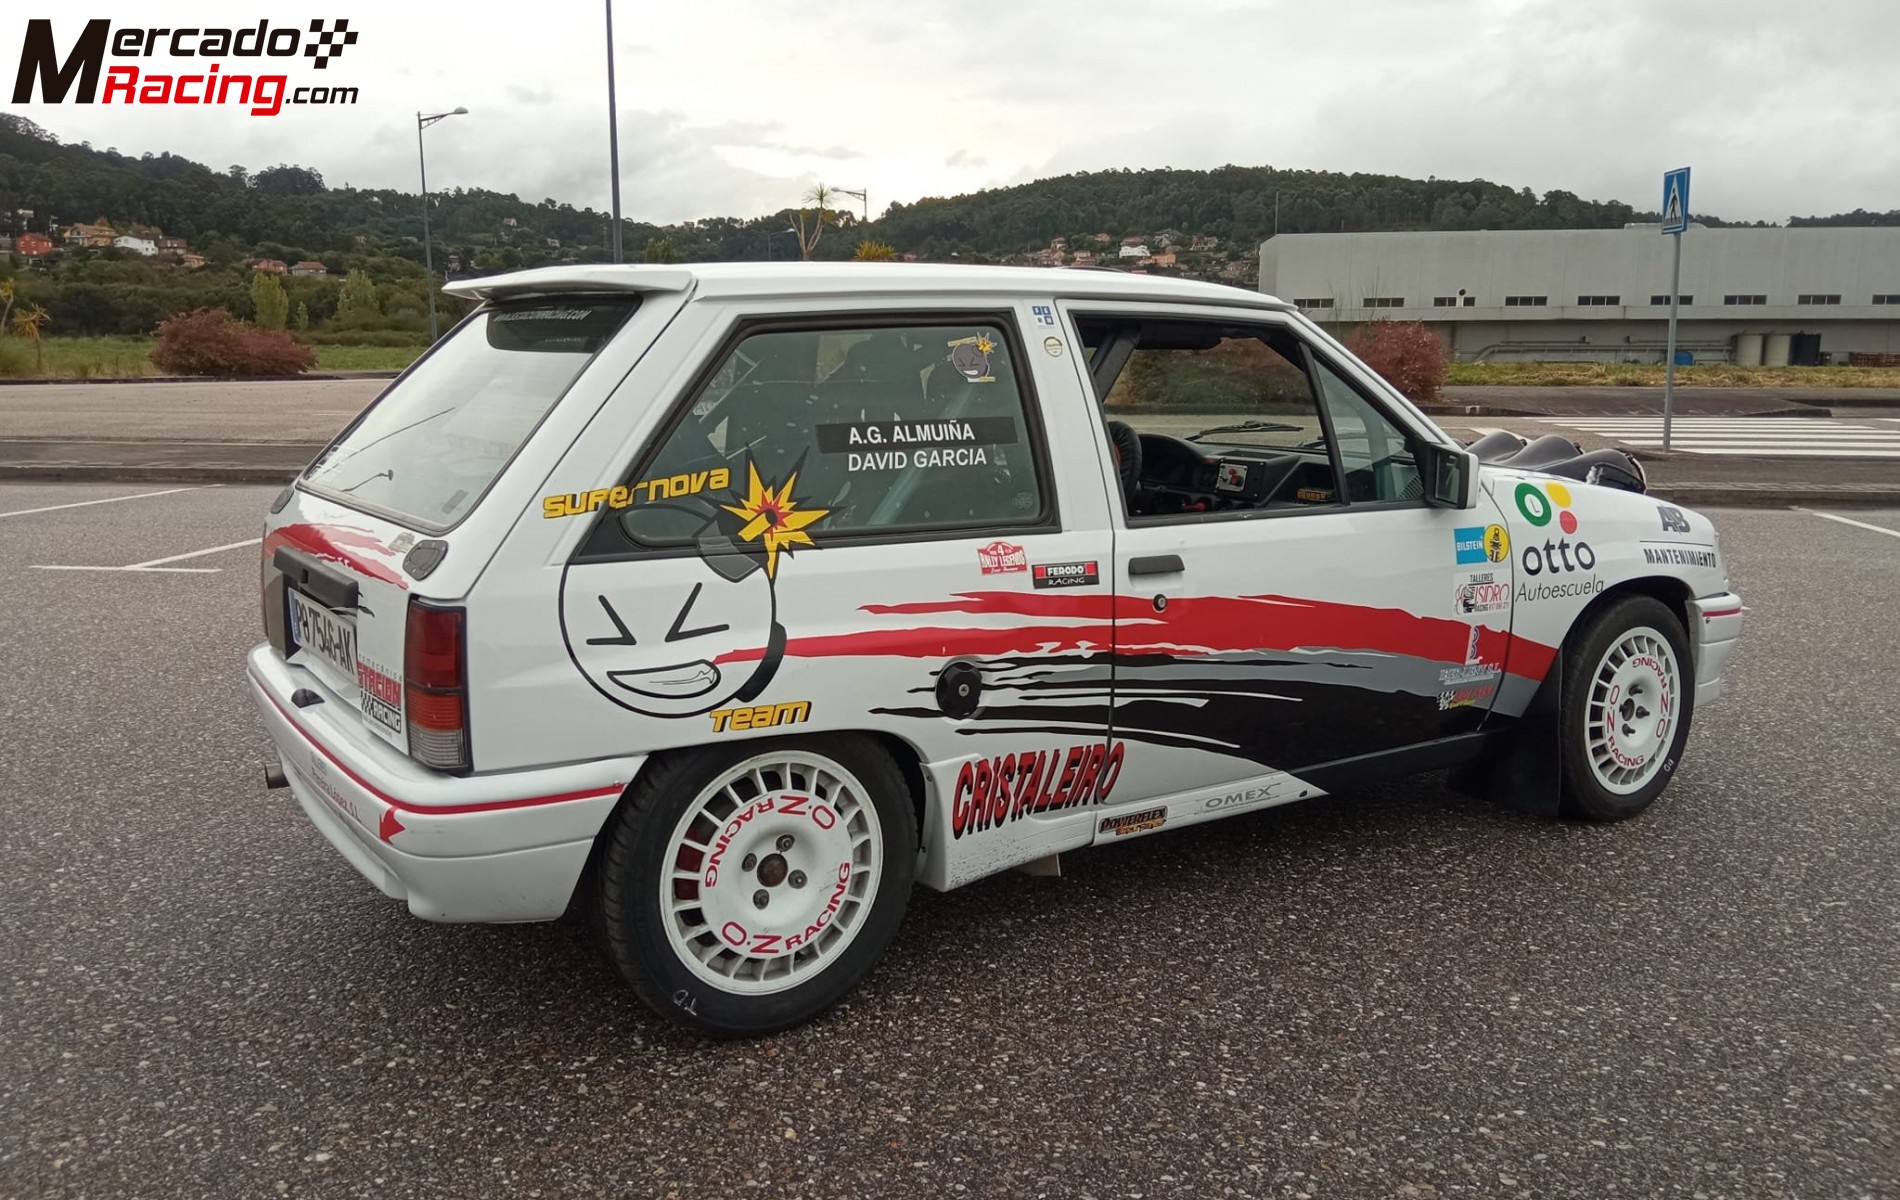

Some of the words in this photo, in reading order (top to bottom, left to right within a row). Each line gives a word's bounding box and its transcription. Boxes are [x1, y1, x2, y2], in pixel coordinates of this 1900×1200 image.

[849, 426, 888, 445] A.G.
[893, 420, 976, 443] ALMUIÑA
[848, 452, 908, 471] DAVID
[914, 448, 988, 468] GARCIA
[997, 544, 1005, 556] 4
[1456, 540, 1483, 551] BILSTEIN
[1522, 537, 1596, 576] otto
[1643, 548, 1716, 568] MANTENIMIENTO
[1047, 565, 1085, 576] FERODO
[1048, 577, 1085, 586] RACING
[1469, 573, 1494, 582] TALLERES
[1515, 573, 1605, 602] Autoescuela
[1632, 657, 1668, 688] RACING
[372, 702, 401, 731] RACING
[1609, 736, 1644, 767] RACING
[952, 742, 1125, 840] CRISTALEIRO
[1205, 785, 1274, 809] OMEX
[1101, 806, 1167, 831] POWERFLEX
[704, 798, 775, 888] RACING
[785, 861, 852, 950] RACING
